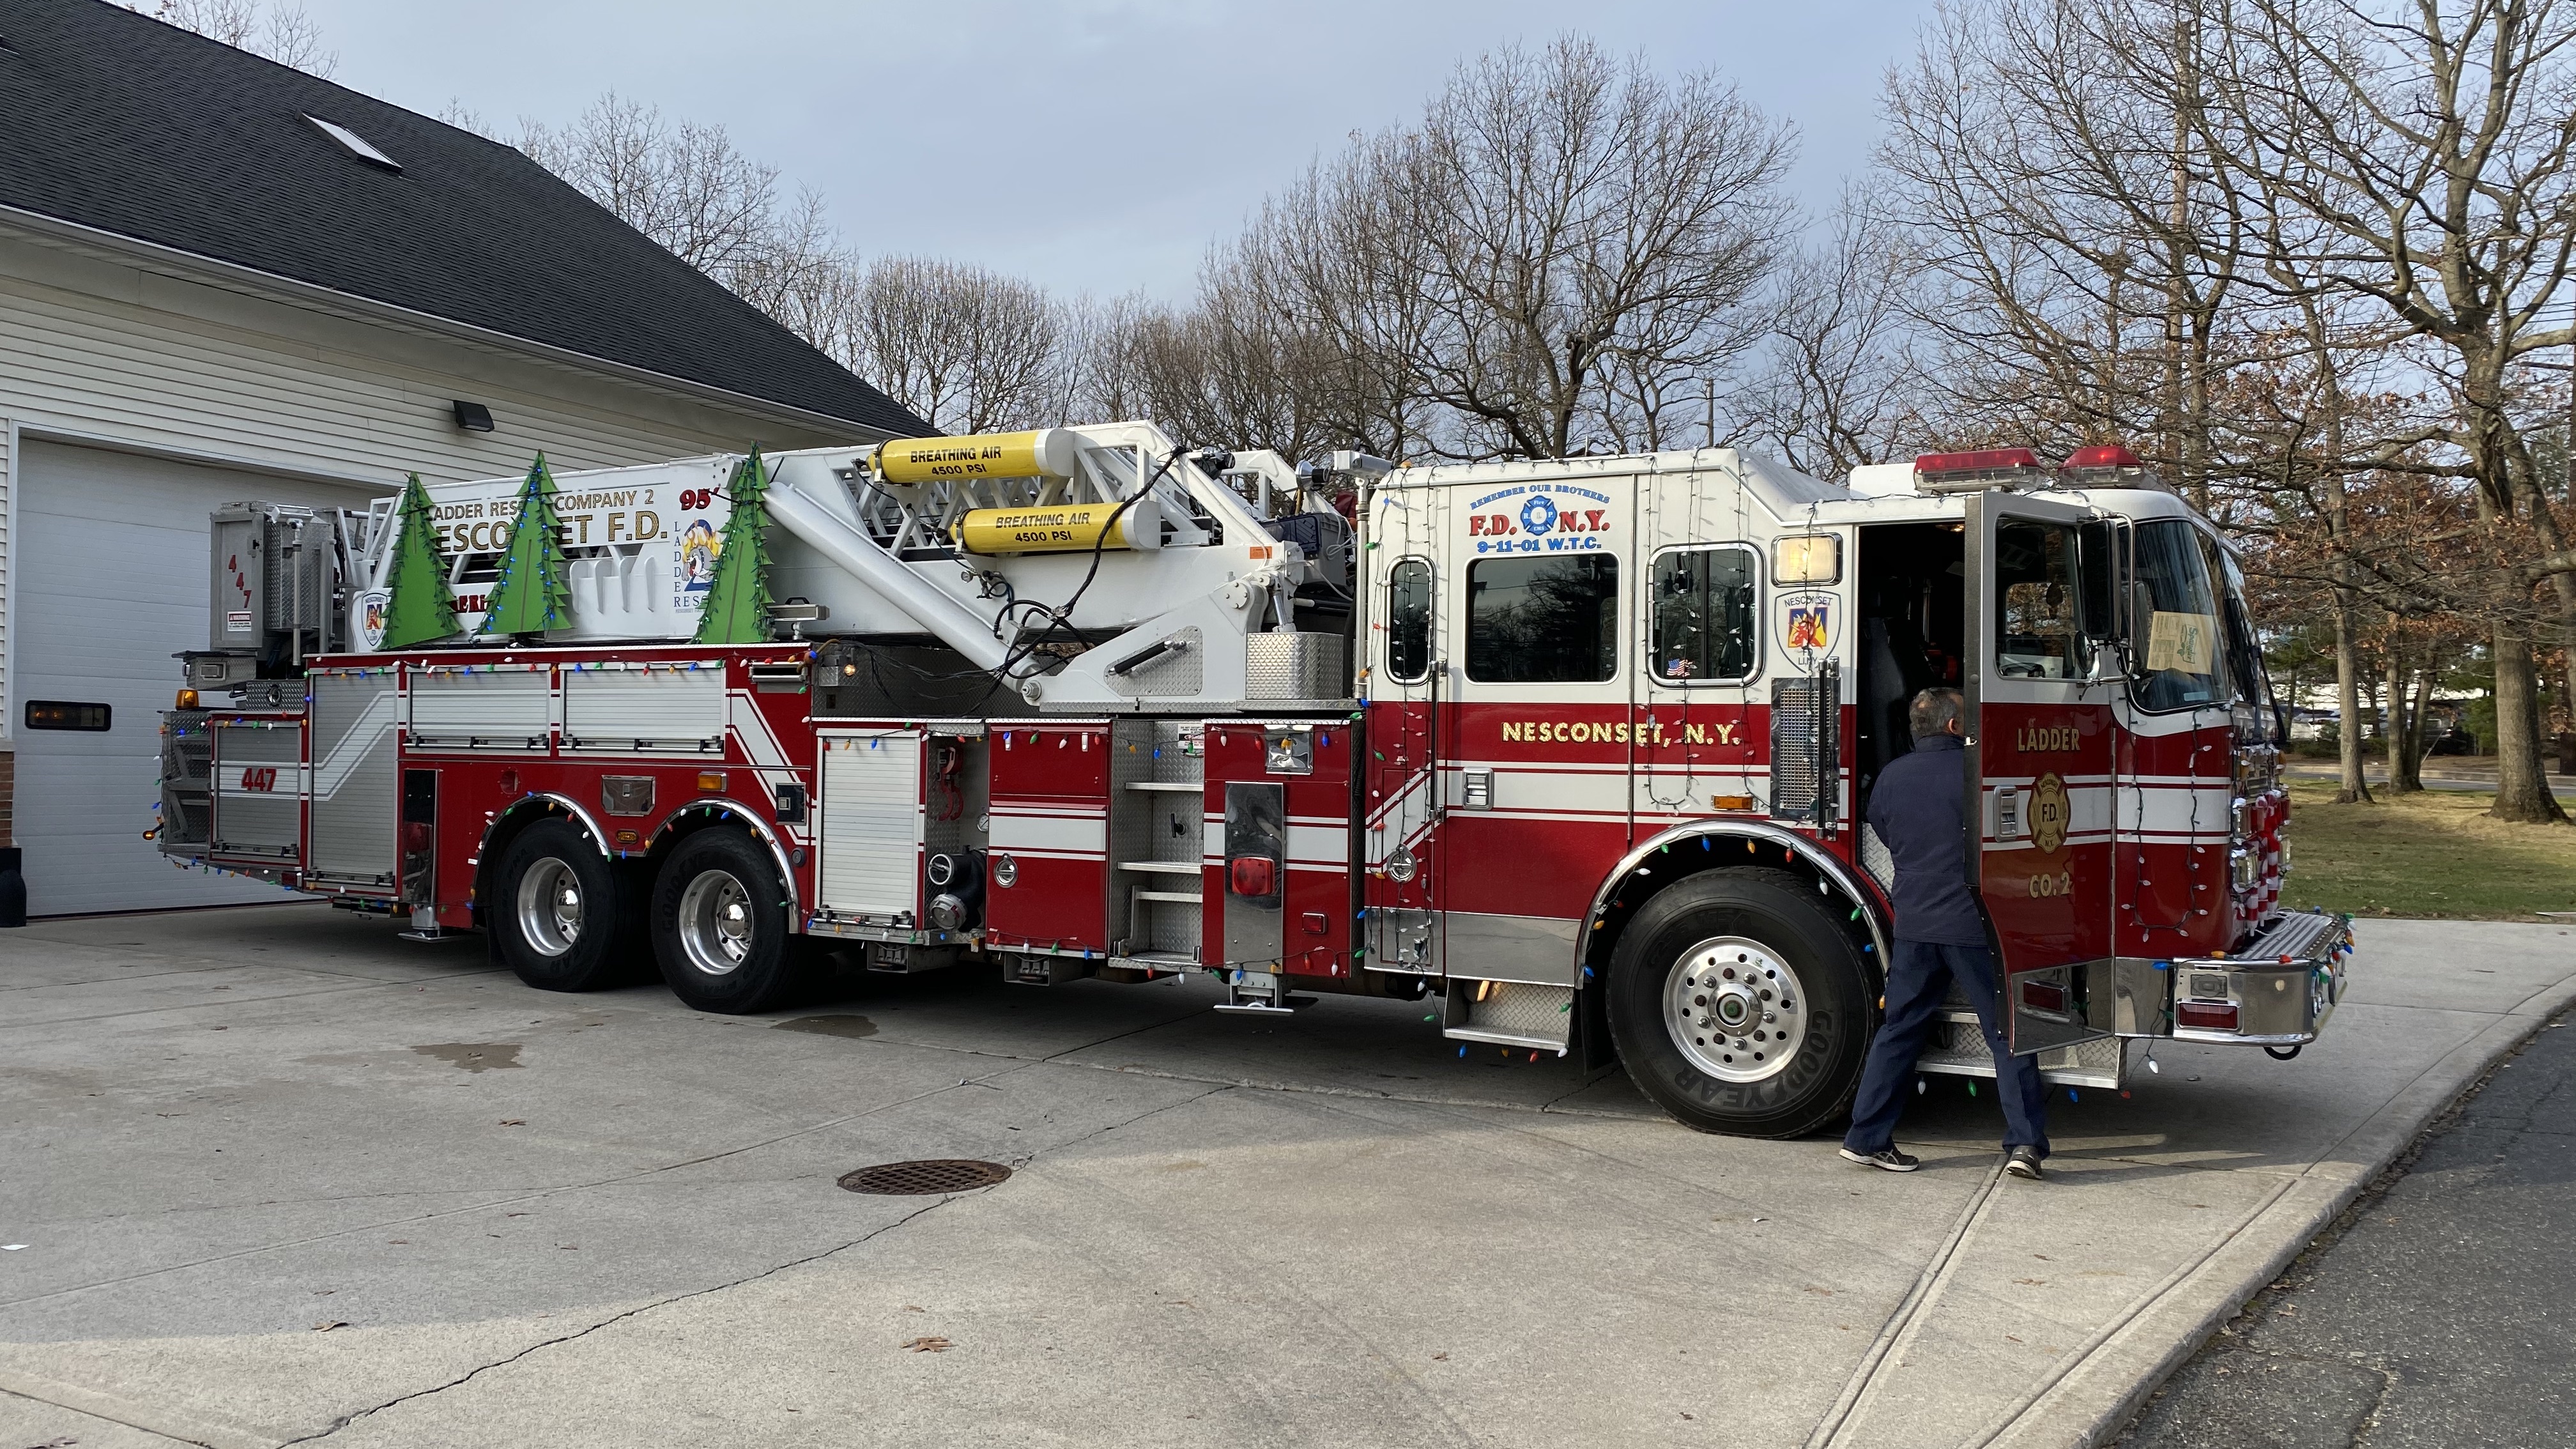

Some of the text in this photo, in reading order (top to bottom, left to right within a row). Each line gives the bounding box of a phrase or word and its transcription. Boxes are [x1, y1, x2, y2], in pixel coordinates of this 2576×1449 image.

[910, 446, 1002, 463] BREATHING AIR
[931, 463, 987, 475] 4500 PSI
[433, 503, 483, 521] ADDER
[554, 490, 638, 511] COMPANY
[644, 489, 654, 505] 2
[1470, 484, 1611, 510] REMEMBER OUR BROTHERS
[608, 510, 668, 542] F.D.
[995, 512, 1090, 529] BREATHING AIR
[1469, 510, 1611, 537] F.D. N.Y.
[1015, 530, 1072, 542] 4500 PSI
[1476, 536, 1602, 553] 9-11-01 W.T.C.
[1784, 595, 1833, 607] NESCONSET
[2186, 627, 2198, 661] Spangler
[1502, 722, 1742, 748] NESCONSET, N.Y.
[2018, 728, 2080, 752] LADDER
[241, 768, 277, 792] 447
[2042, 803, 2058, 823] F.D.
[2029, 872, 2070, 898] CO. 2
[1674, 1010, 1833, 1108] GOODYEAR
